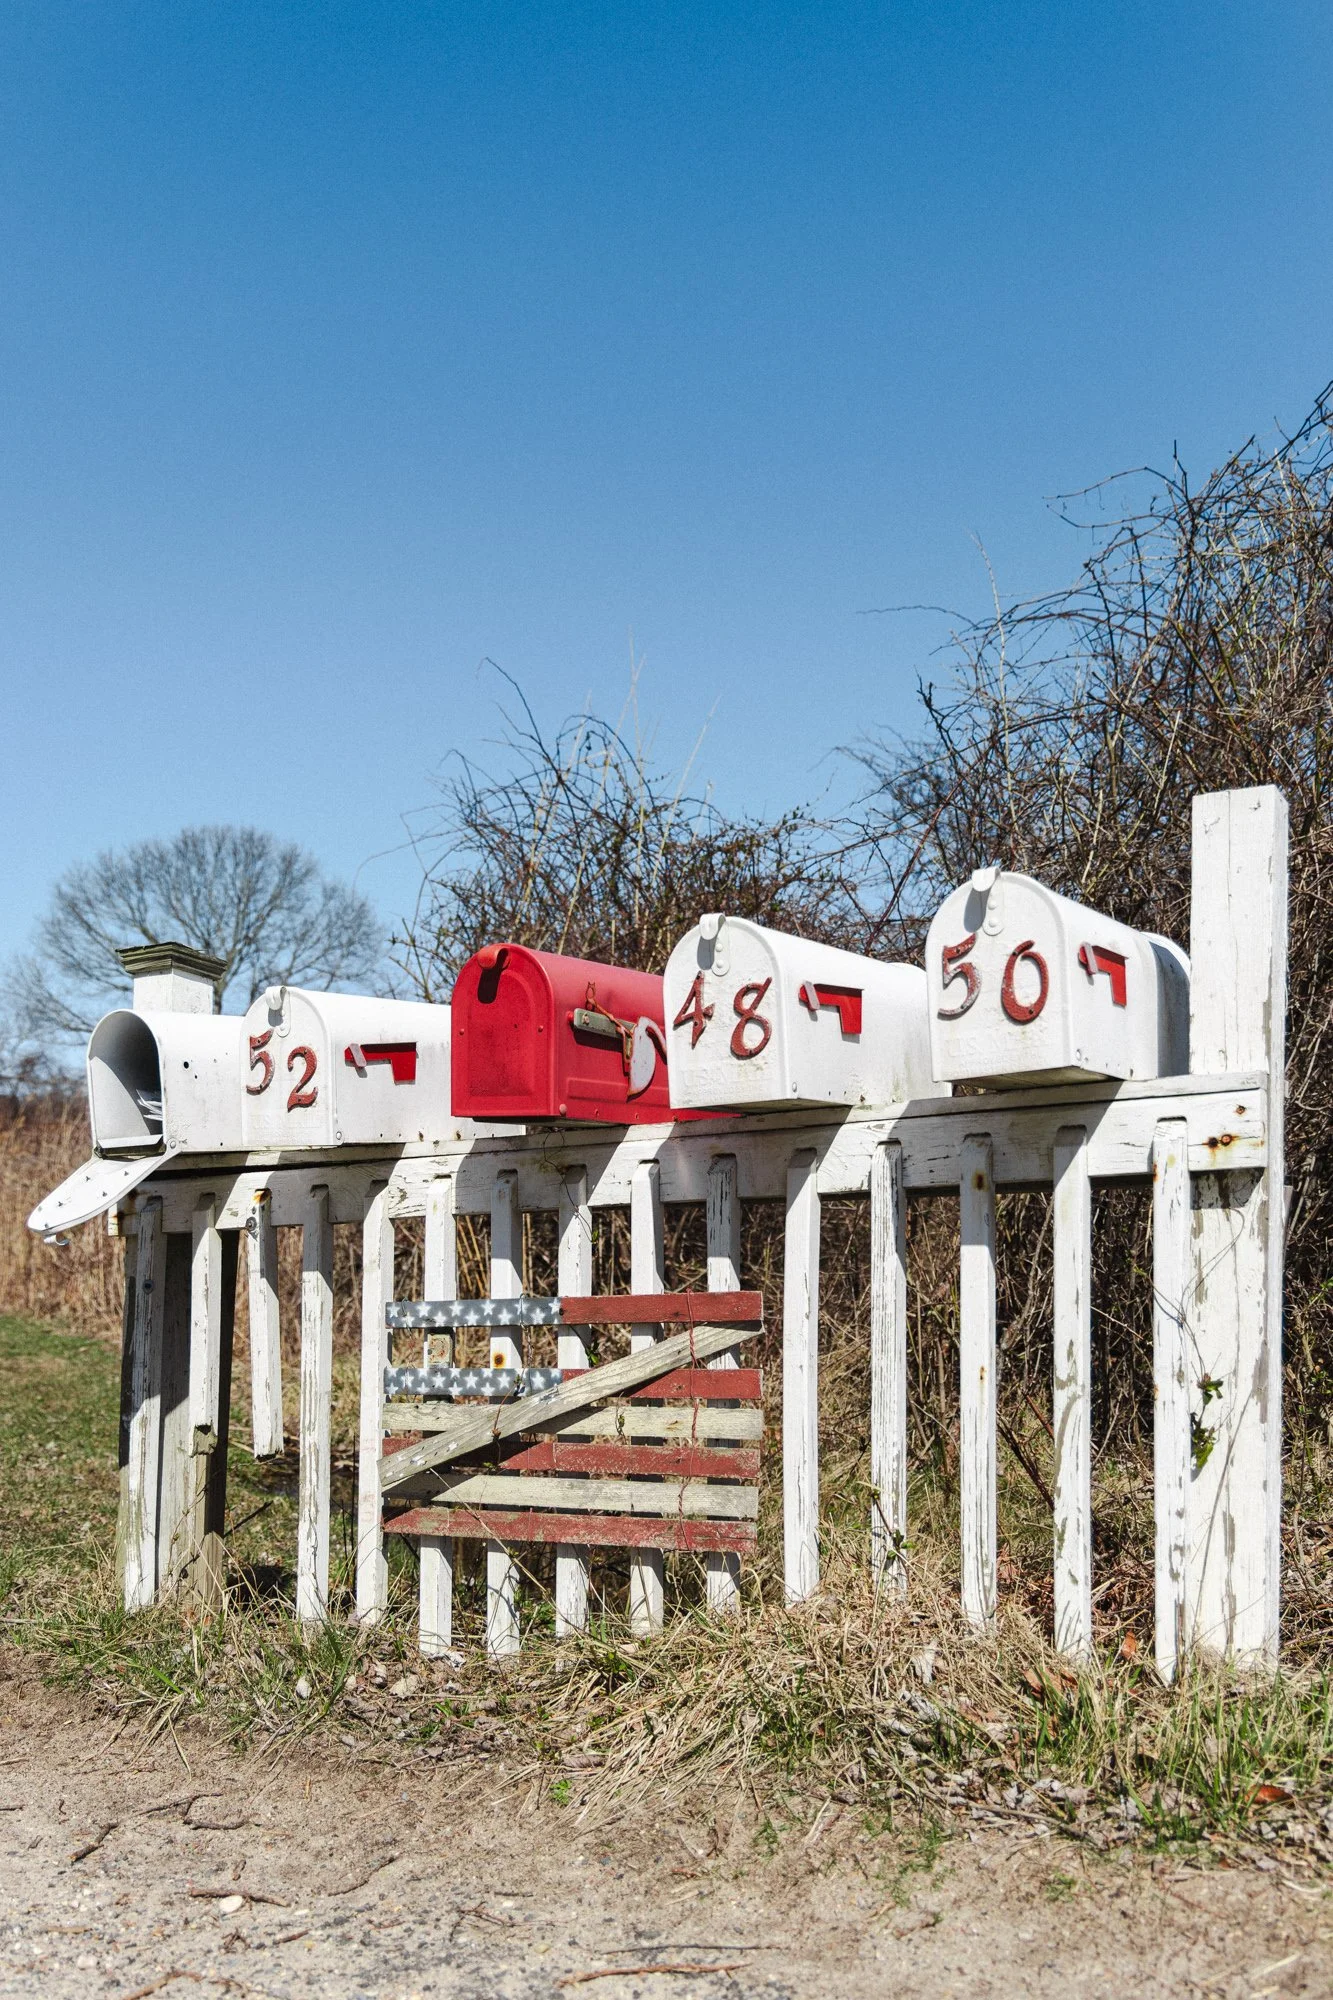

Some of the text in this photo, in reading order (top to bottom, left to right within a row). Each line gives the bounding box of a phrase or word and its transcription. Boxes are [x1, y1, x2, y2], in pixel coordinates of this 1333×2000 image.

[673, 971, 773, 1060] 48
[937, 932, 1049, 1024] 50
[246, 1028, 319, 1113] 52
